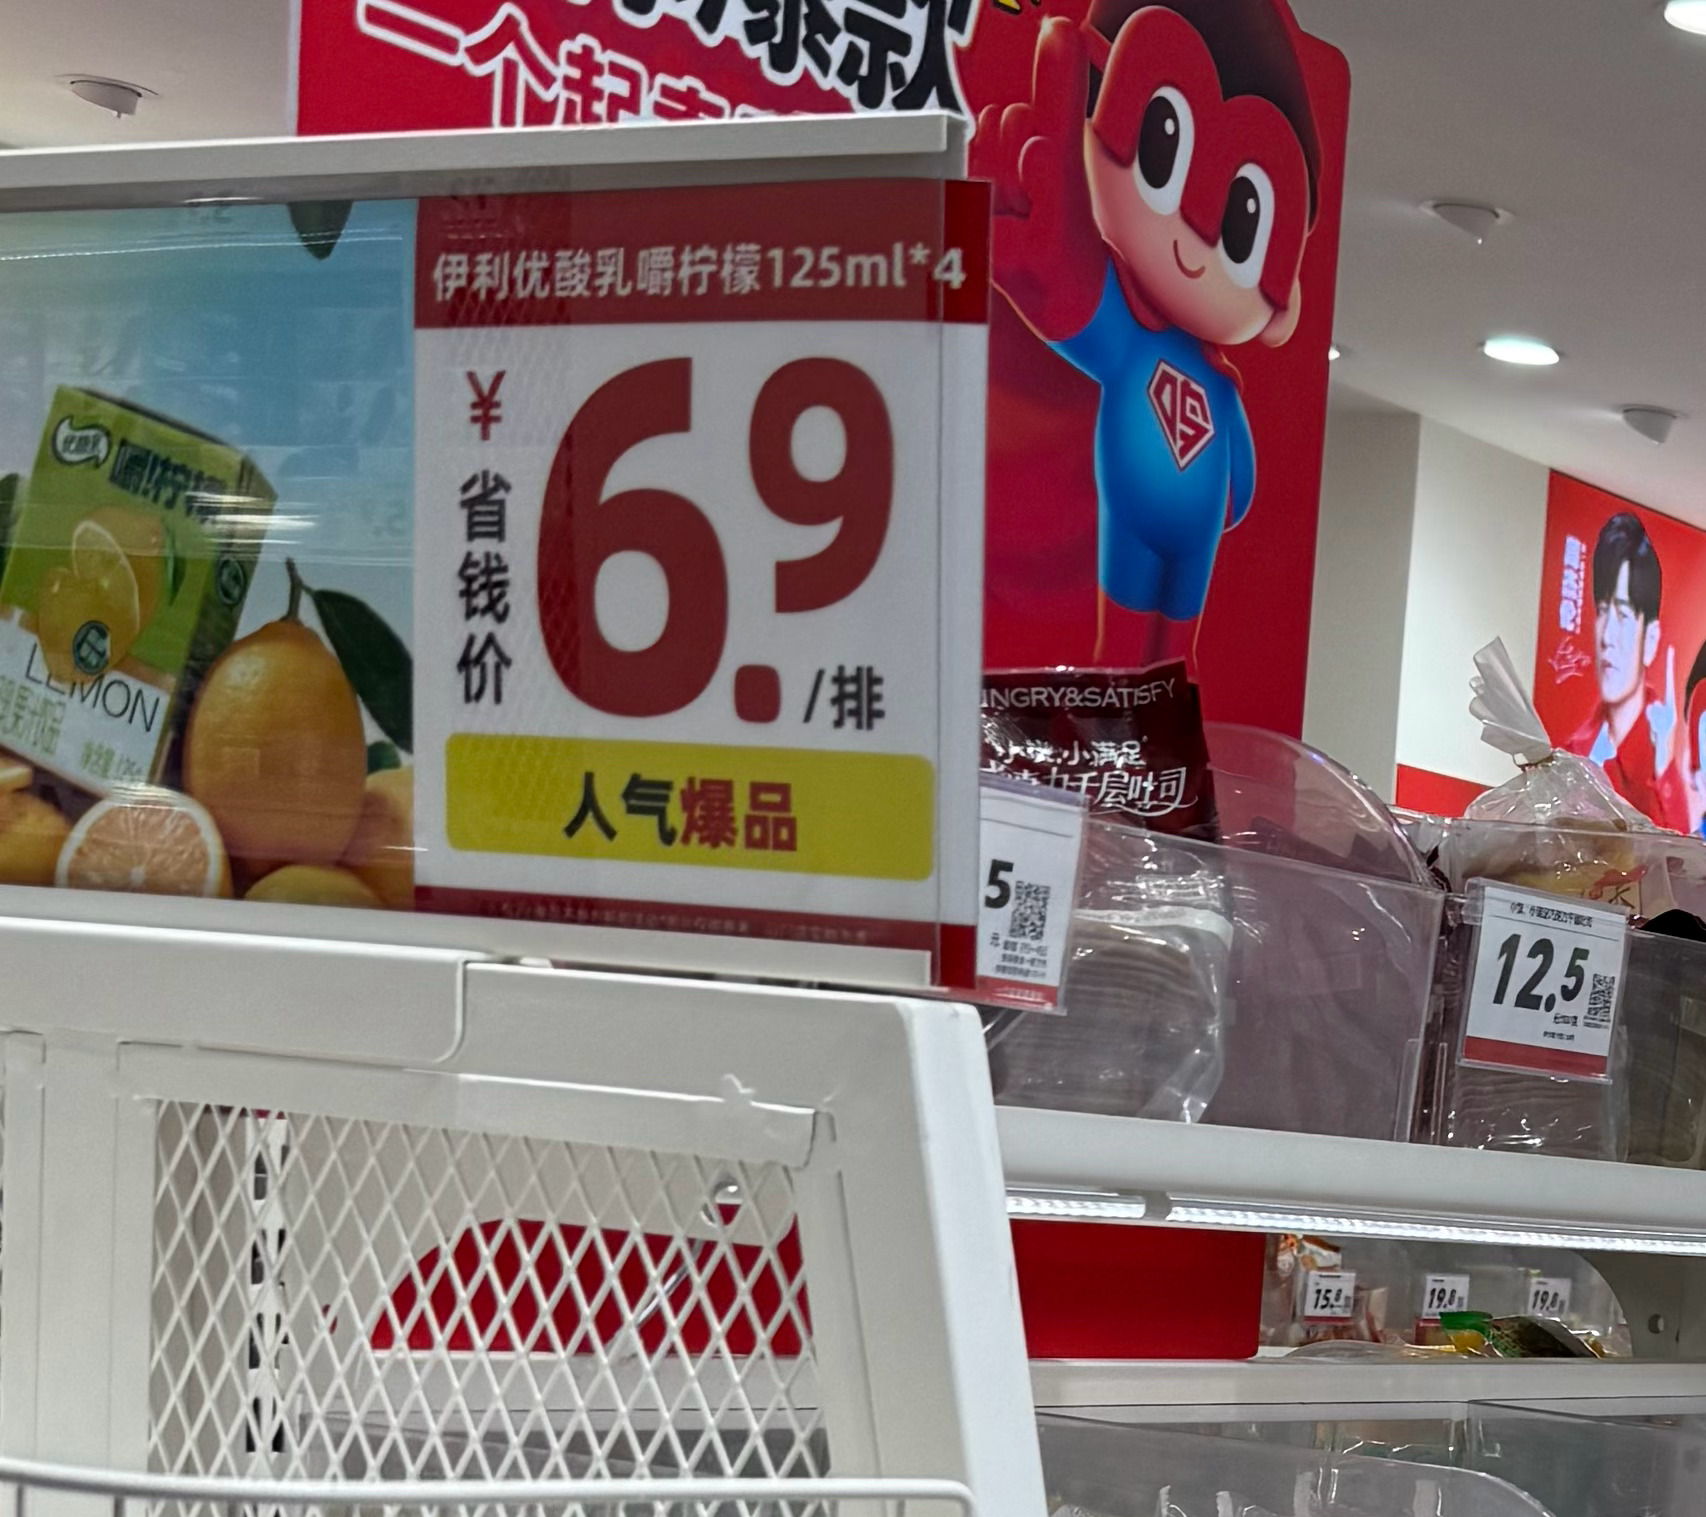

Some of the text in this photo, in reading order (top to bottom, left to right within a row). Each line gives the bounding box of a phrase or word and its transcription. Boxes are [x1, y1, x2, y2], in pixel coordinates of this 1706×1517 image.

[466, 370, 506, 442] ¥
[537, 356, 895, 724] 6.9
[457, 470, 513, 705] 省钱价
[803, 664, 886, 730] /排
[563, 770, 798, 852] 人气爆品
[1492, 933, 1591, 1013] 12.5
